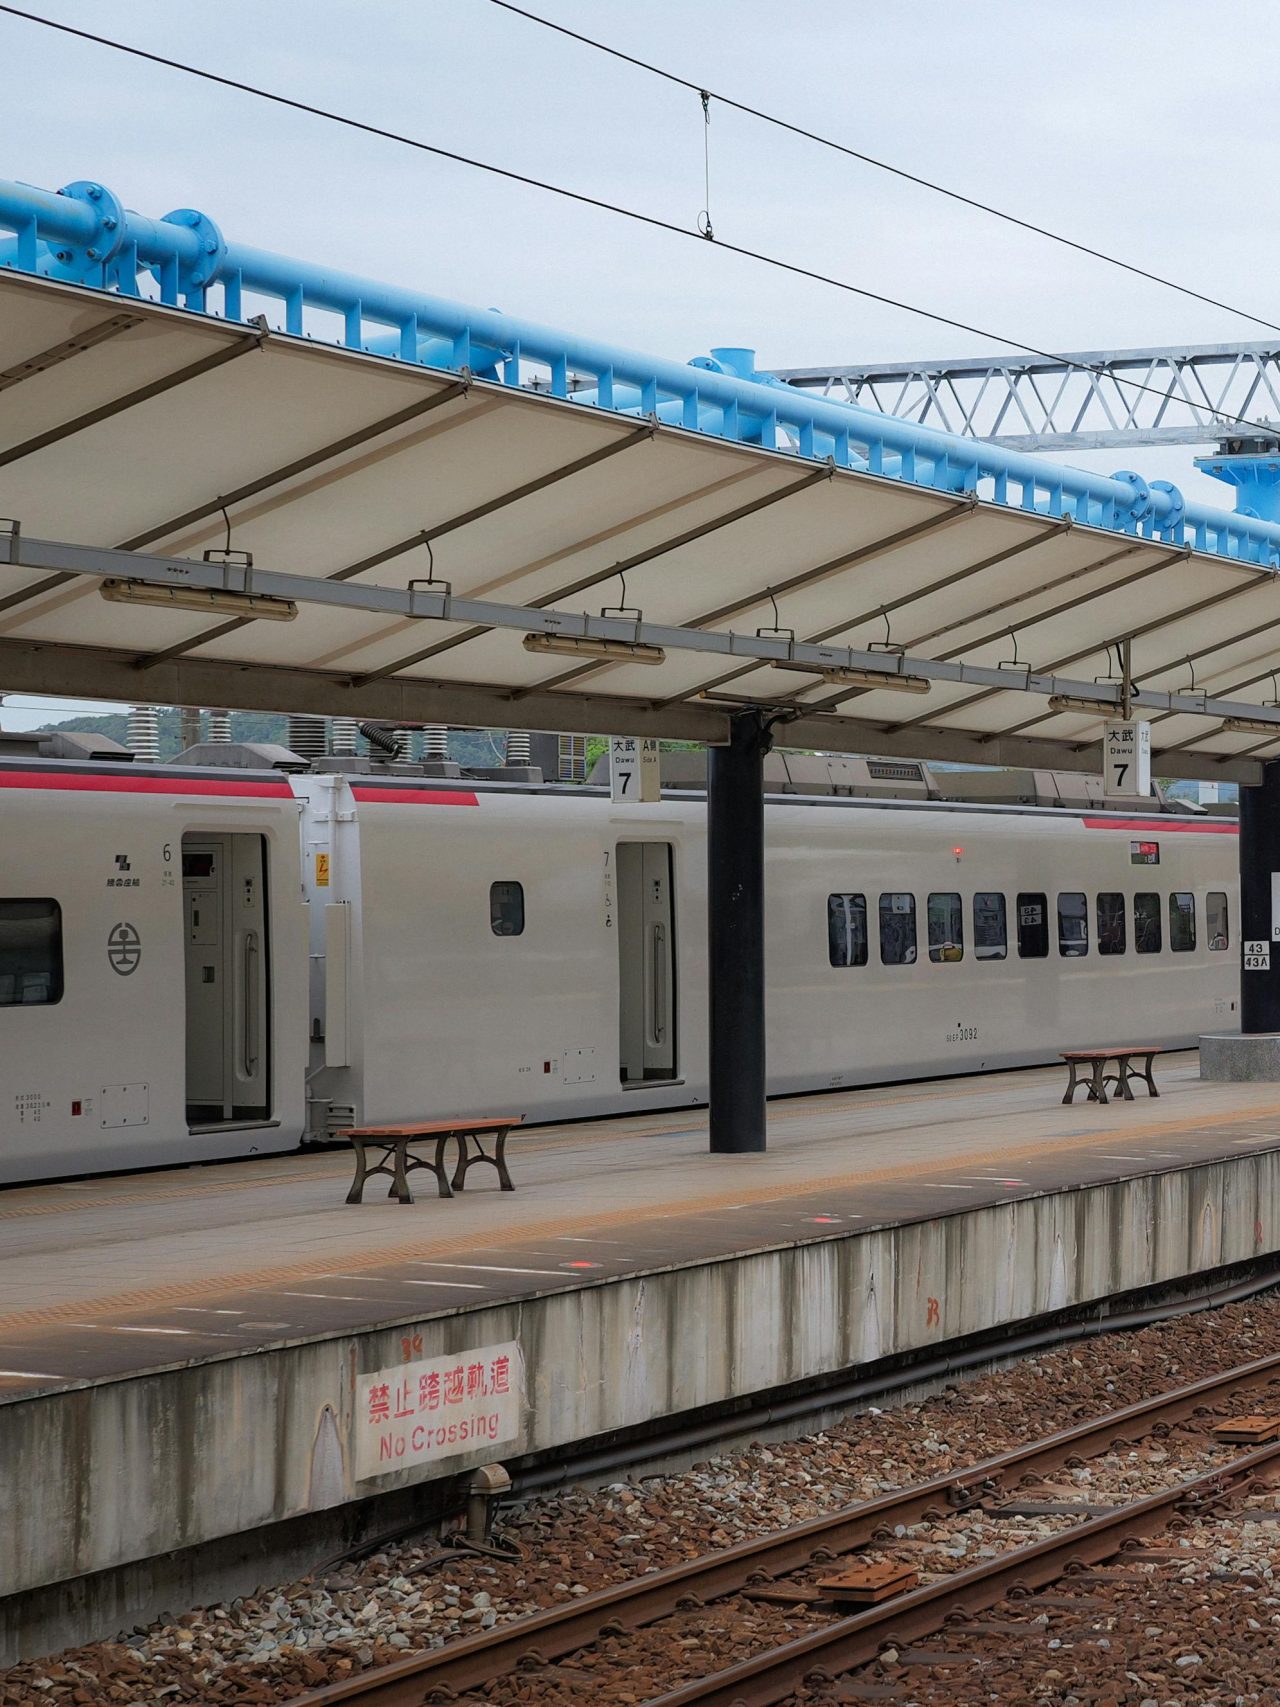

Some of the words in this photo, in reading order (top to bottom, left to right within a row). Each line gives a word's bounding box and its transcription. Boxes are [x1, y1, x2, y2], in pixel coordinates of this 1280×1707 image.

[1108, 729, 1133, 741] 大武
[613, 739, 635, 751] 大武
[1113, 763, 1129, 787] 7
[618, 772, 632, 795] 7
[163, 843, 171, 861] 6
[603, 851, 610, 866] 7
[1248, 943, 1263, 953] 43
[1245, 957, 1268, 967] 43A
[368, 1354, 510, 1424] 禁止跨越軌道
[379, 1432, 406, 1461] No
[411, 1412, 499, 1451] Crossing
